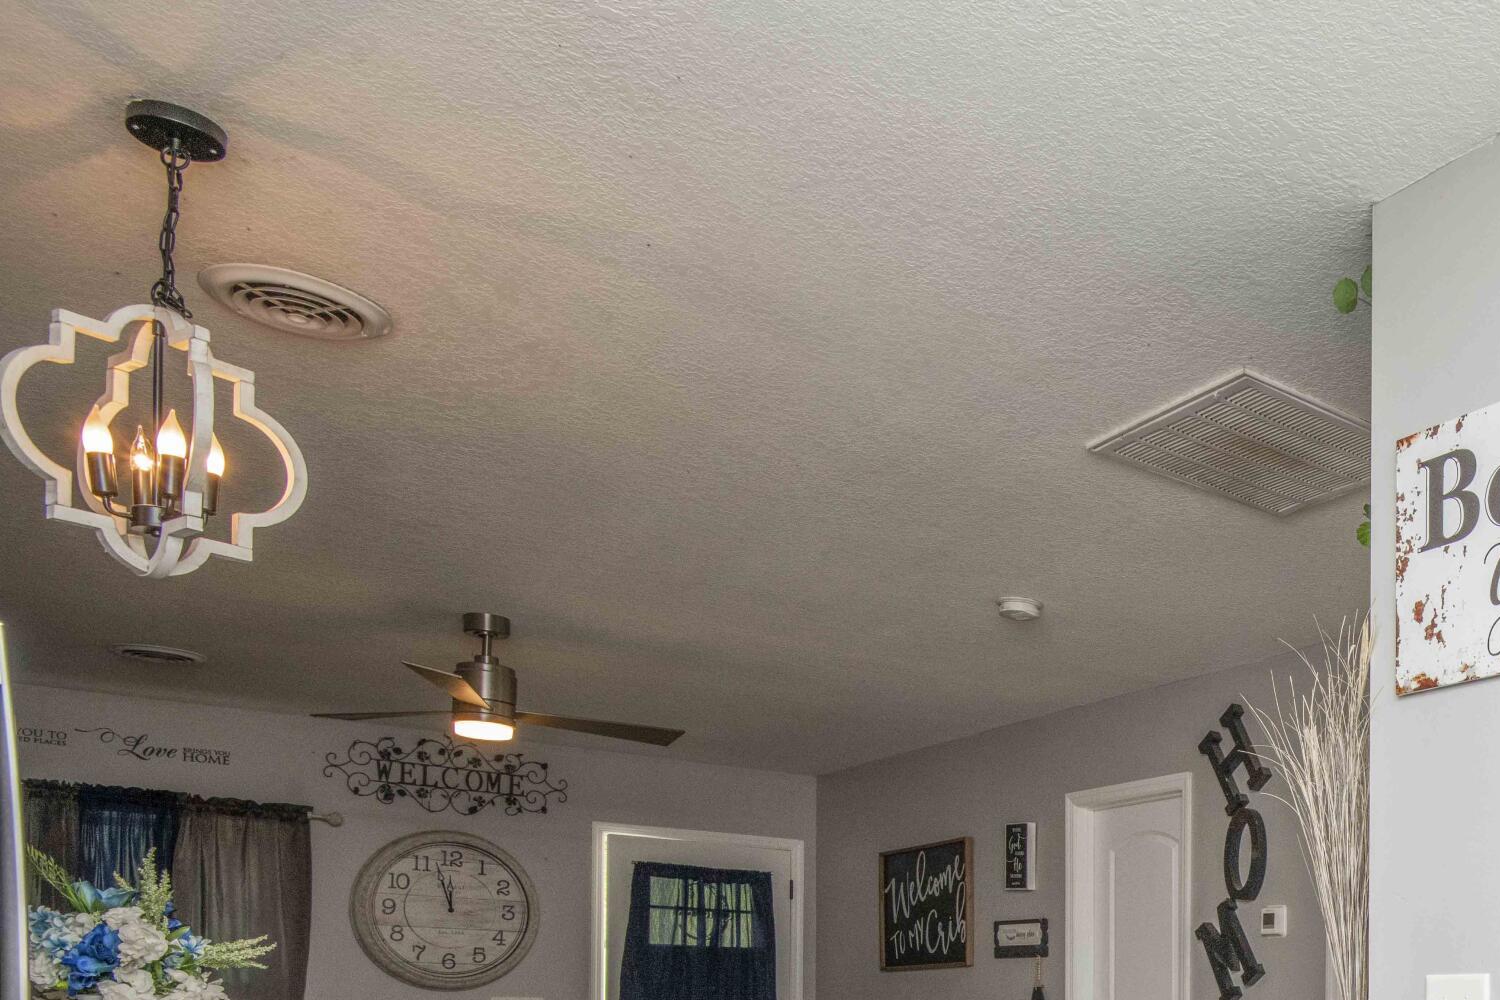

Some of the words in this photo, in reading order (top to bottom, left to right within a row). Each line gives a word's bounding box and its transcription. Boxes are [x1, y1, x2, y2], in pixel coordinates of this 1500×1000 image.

[47, 730, 67, 740] TO
[183, 752, 231, 765] HOME
[376, 759, 528, 797] WELCOME
[412, 854, 432, 872] 11
[440, 850, 463, 868] 12
[478, 860, 487, 876] 1
[388, 872, 410, 890] 10
[496, 880, 510, 896] 2
[884, 851, 966, 924] Welcome
[382, 898, 396, 915] 9
[502, 905, 515, 921] 3
[889, 930, 906, 960] TO
[908, 916, 924, 952] MY
[925, 881, 966, 955] Crib
[390, 924, 404, 942] 8
[492, 930, 506, 946] 4
[412, 944, 426, 961] 7
[472, 947, 486, 963] 5
[441, 953, 456, 970] 6
